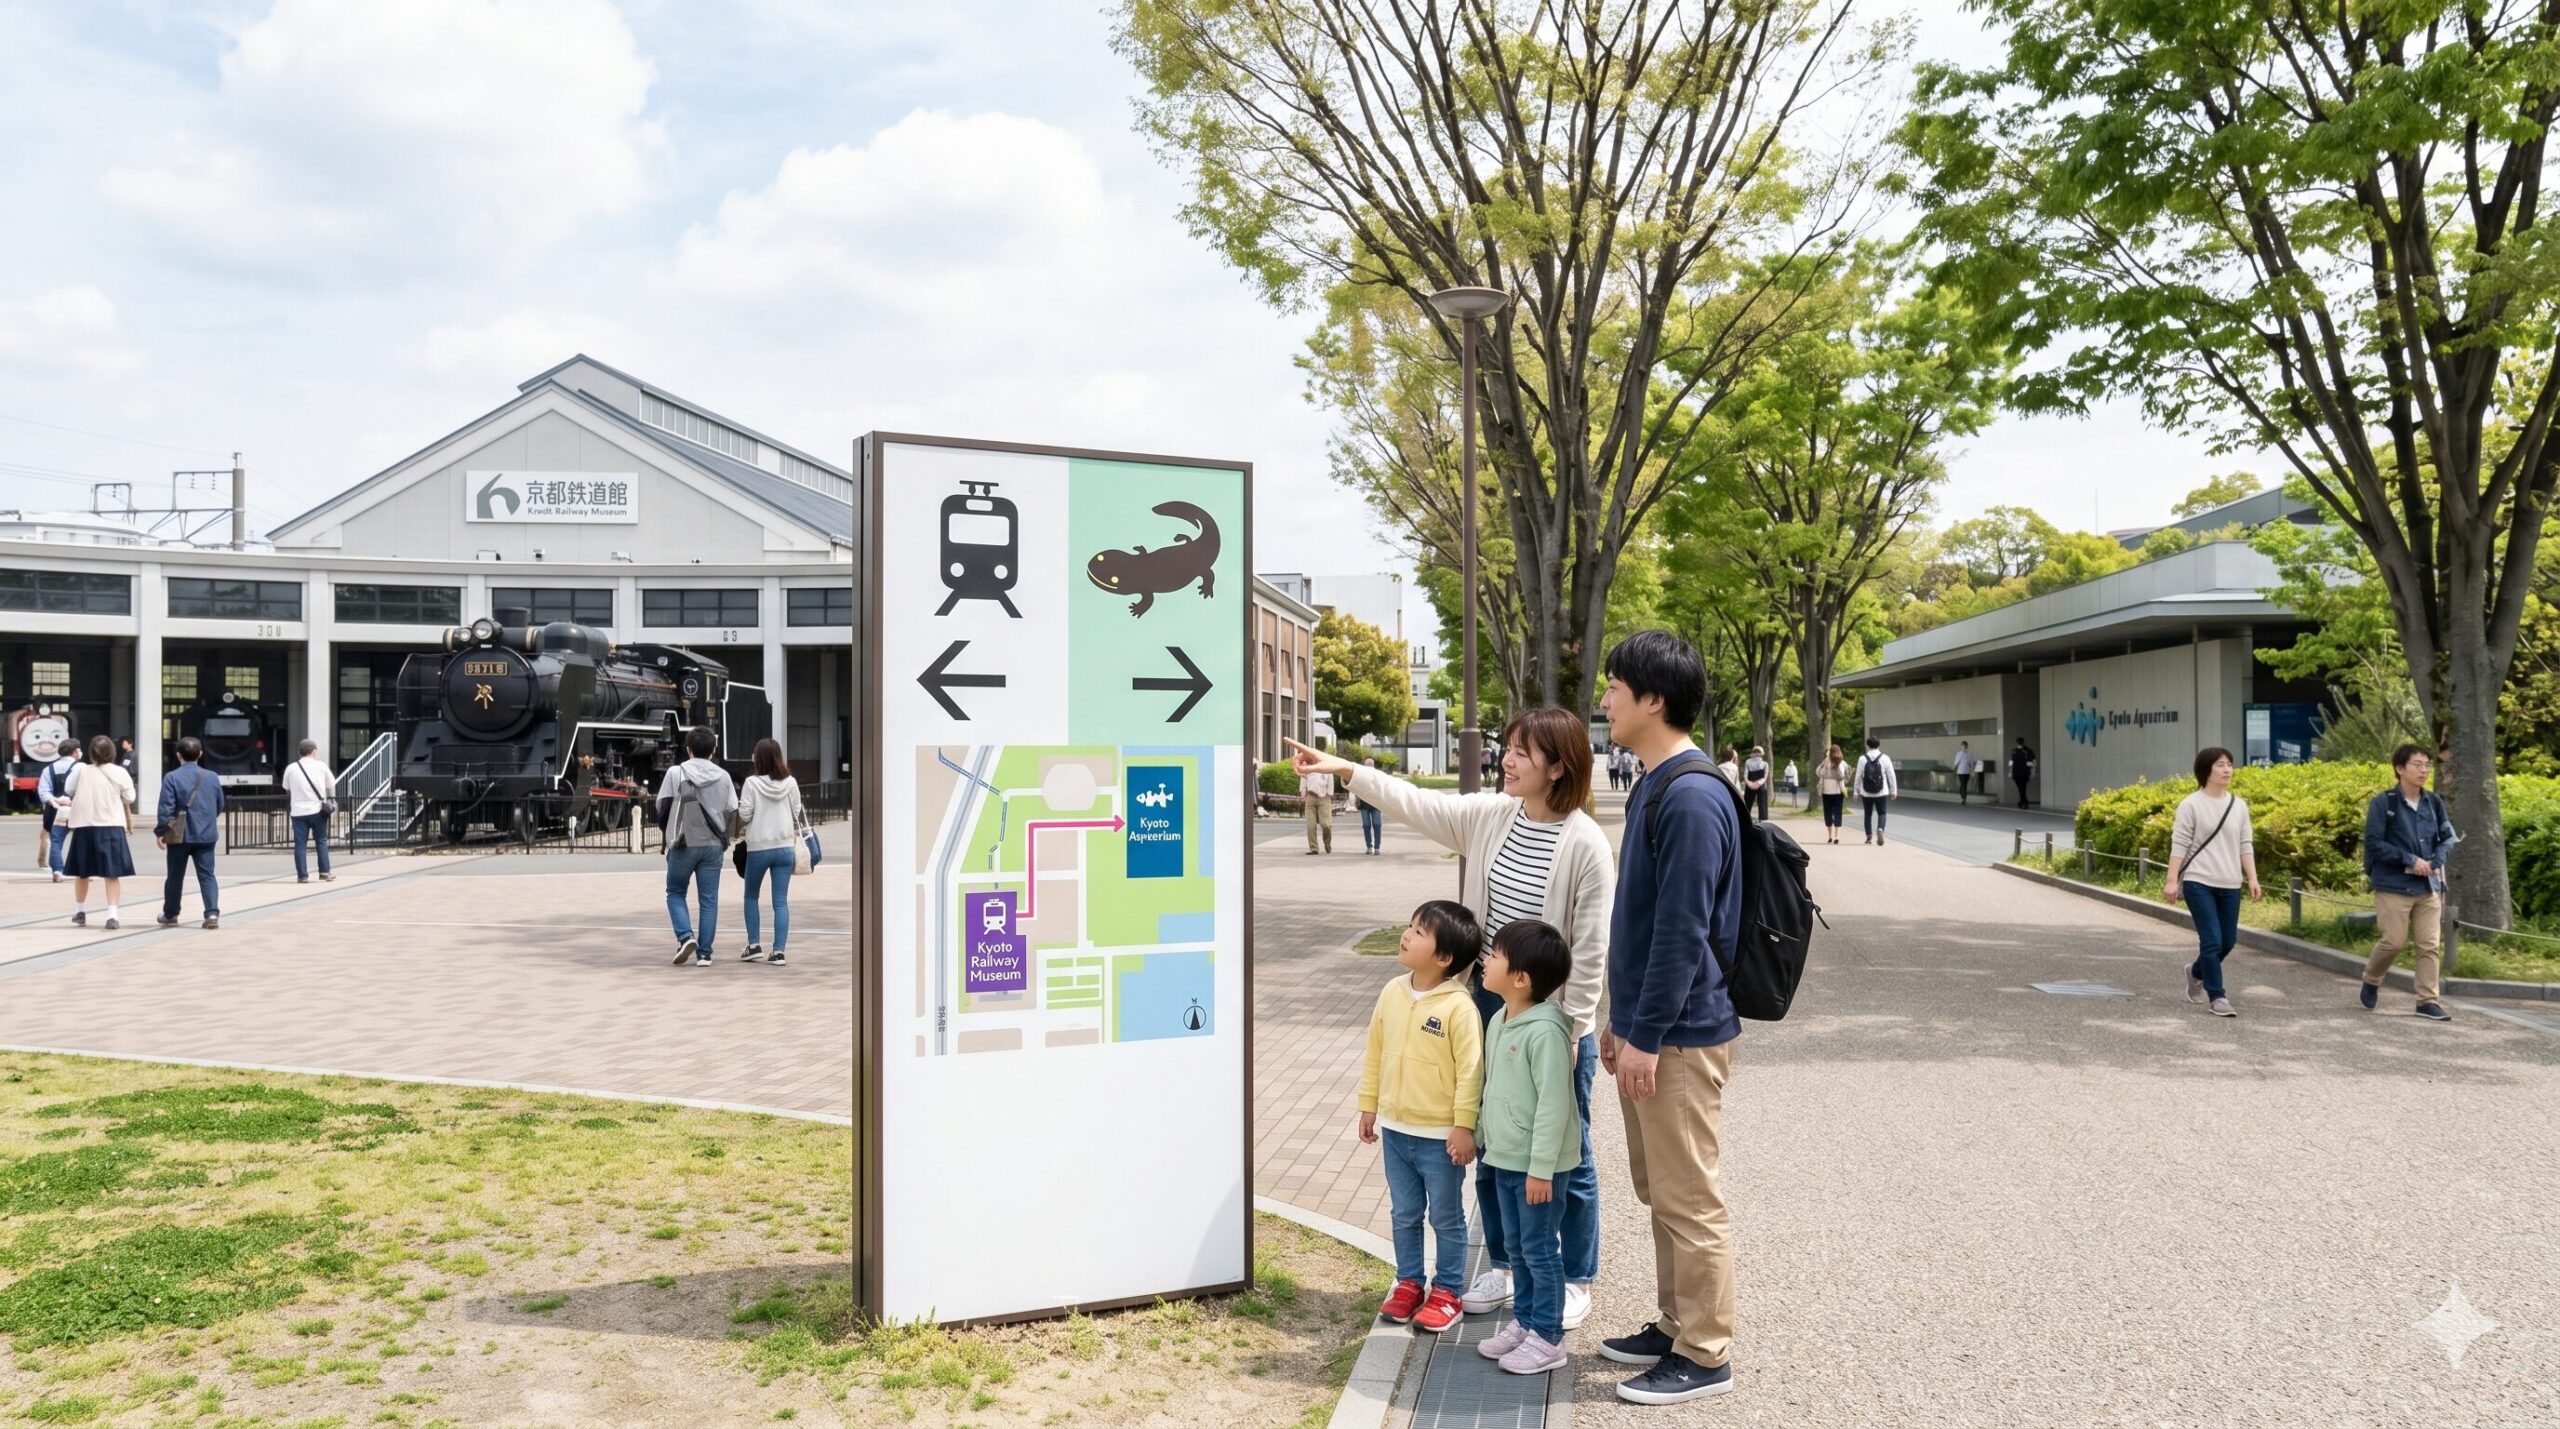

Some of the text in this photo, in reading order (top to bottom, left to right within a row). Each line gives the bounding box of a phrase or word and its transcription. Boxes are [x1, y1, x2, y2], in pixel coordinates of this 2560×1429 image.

[526, 480, 627, 505] 京都鉄道館
[555, 507, 588, 517] Railway
[591, 508, 627, 516] Museum
[1140, 817, 1169, 831] Kyoto
[978, 941, 1013, 955] Kyoto
[971, 954, 1019, 969] Railway
[970, 969, 1021, 982] Museum
